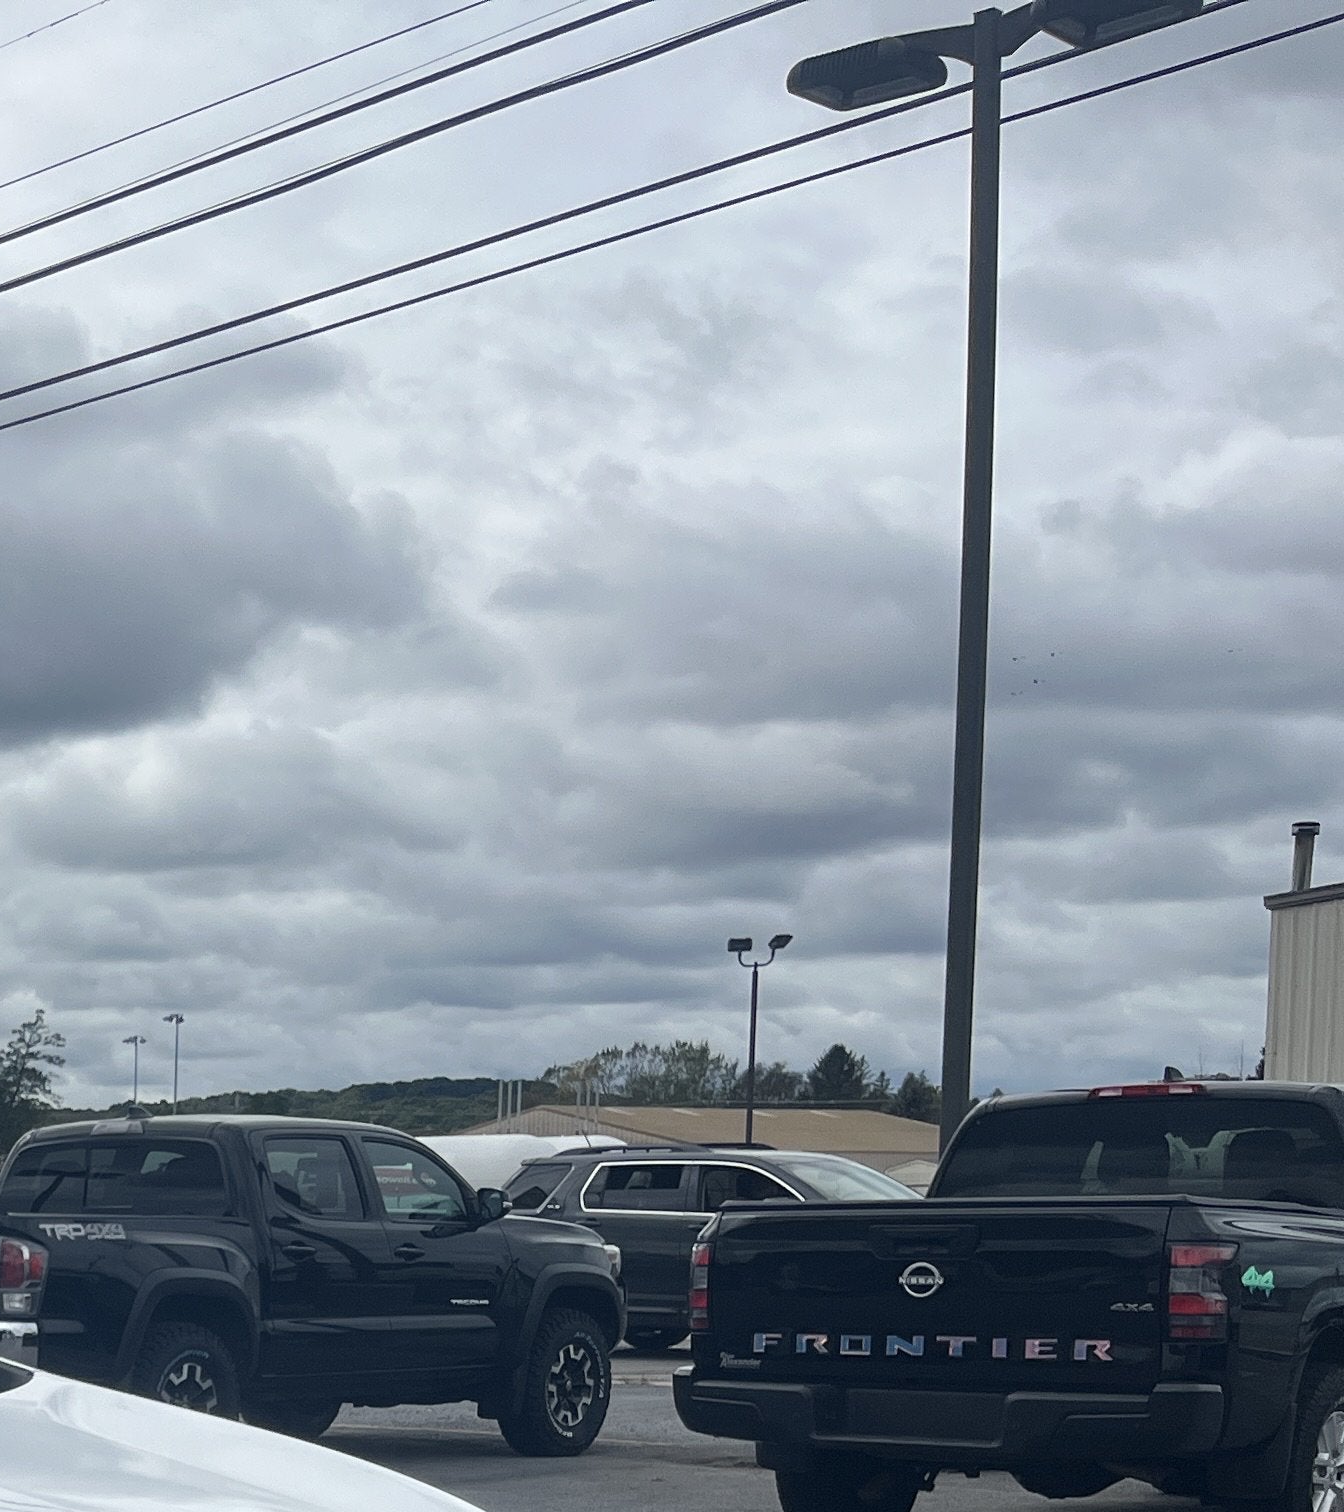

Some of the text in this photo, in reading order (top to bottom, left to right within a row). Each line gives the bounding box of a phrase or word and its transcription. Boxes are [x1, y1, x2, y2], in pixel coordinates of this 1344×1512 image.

[39, 1223, 86, 1241] TRD
[898, 1275, 944, 1285] NISSAN
[753, 1333, 1113, 1361] FRONTIER
